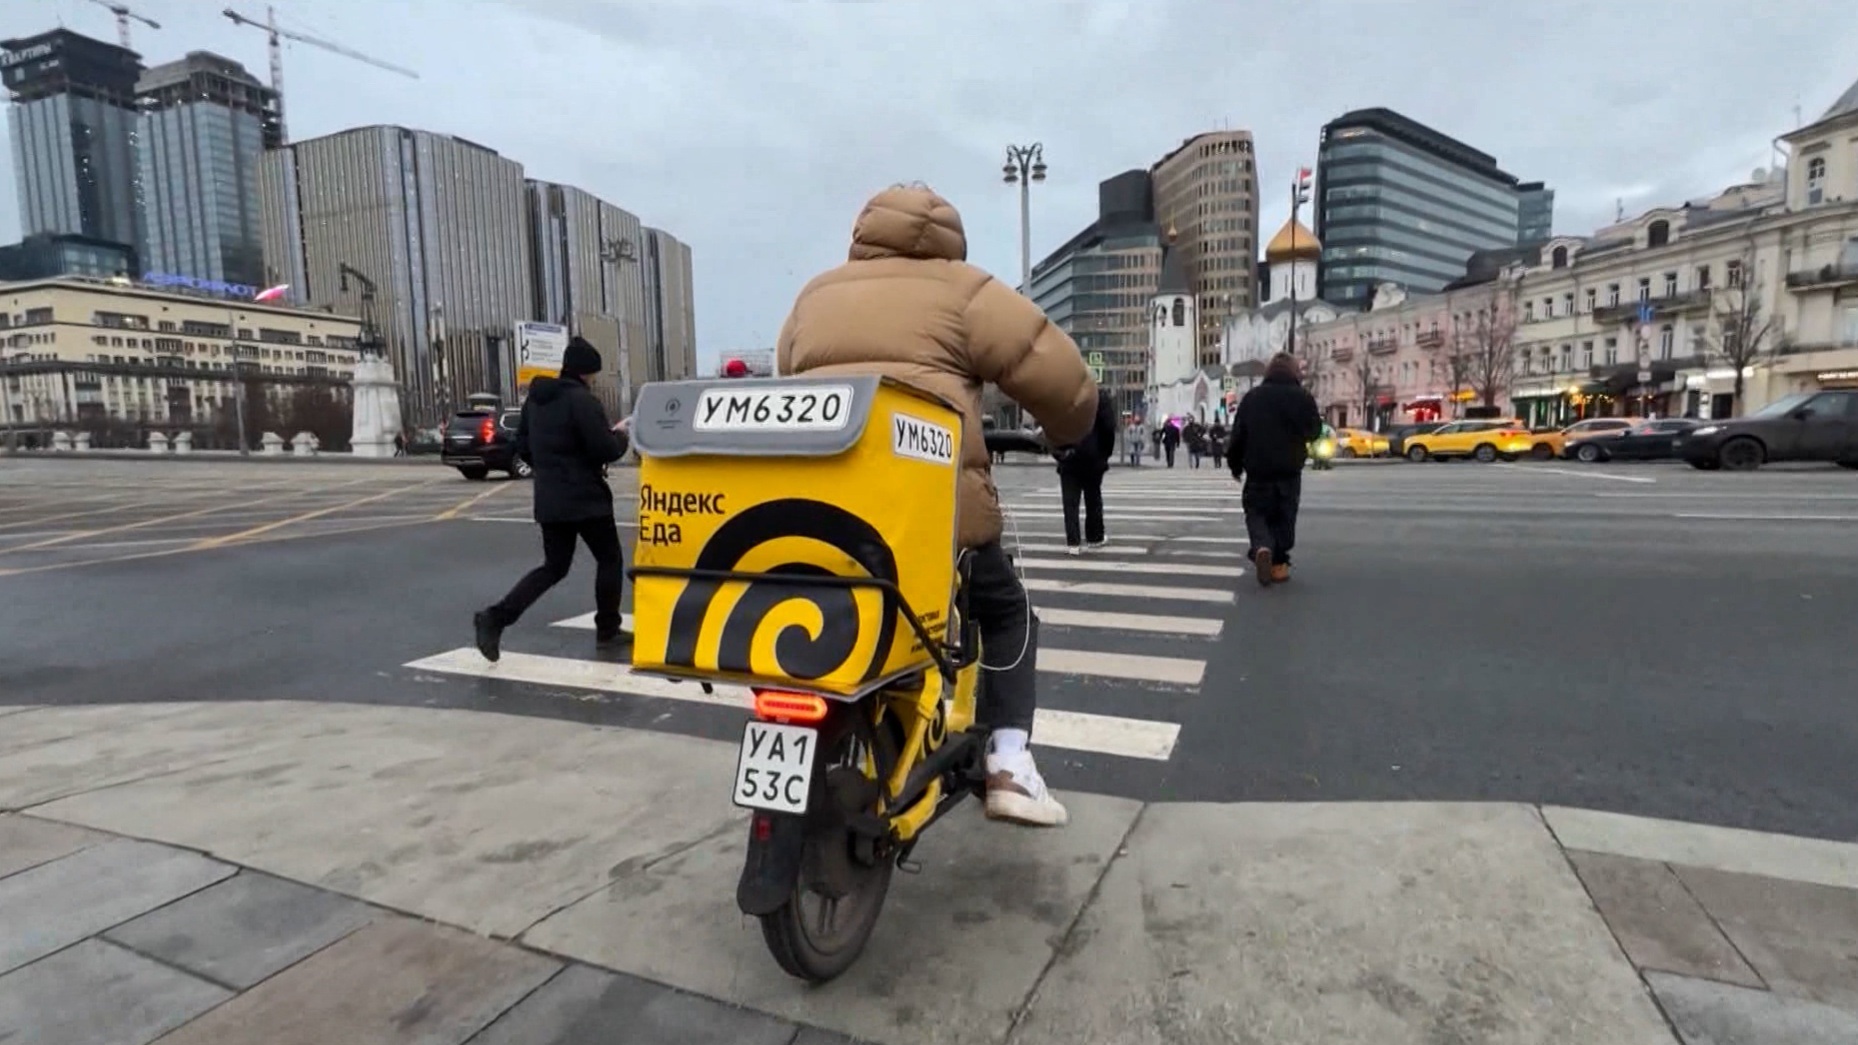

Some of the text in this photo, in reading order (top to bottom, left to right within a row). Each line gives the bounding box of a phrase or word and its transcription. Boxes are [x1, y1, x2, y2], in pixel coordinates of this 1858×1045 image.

[704, 393, 841, 424] УМ6320
[896, 418, 953, 459] УМ6320
[640, 483, 726, 517] Яндекс
[640, 514, 682, 547] Еда
[749, 727, 809, 765] УА1
[742, 767, 804, 805] 53С
